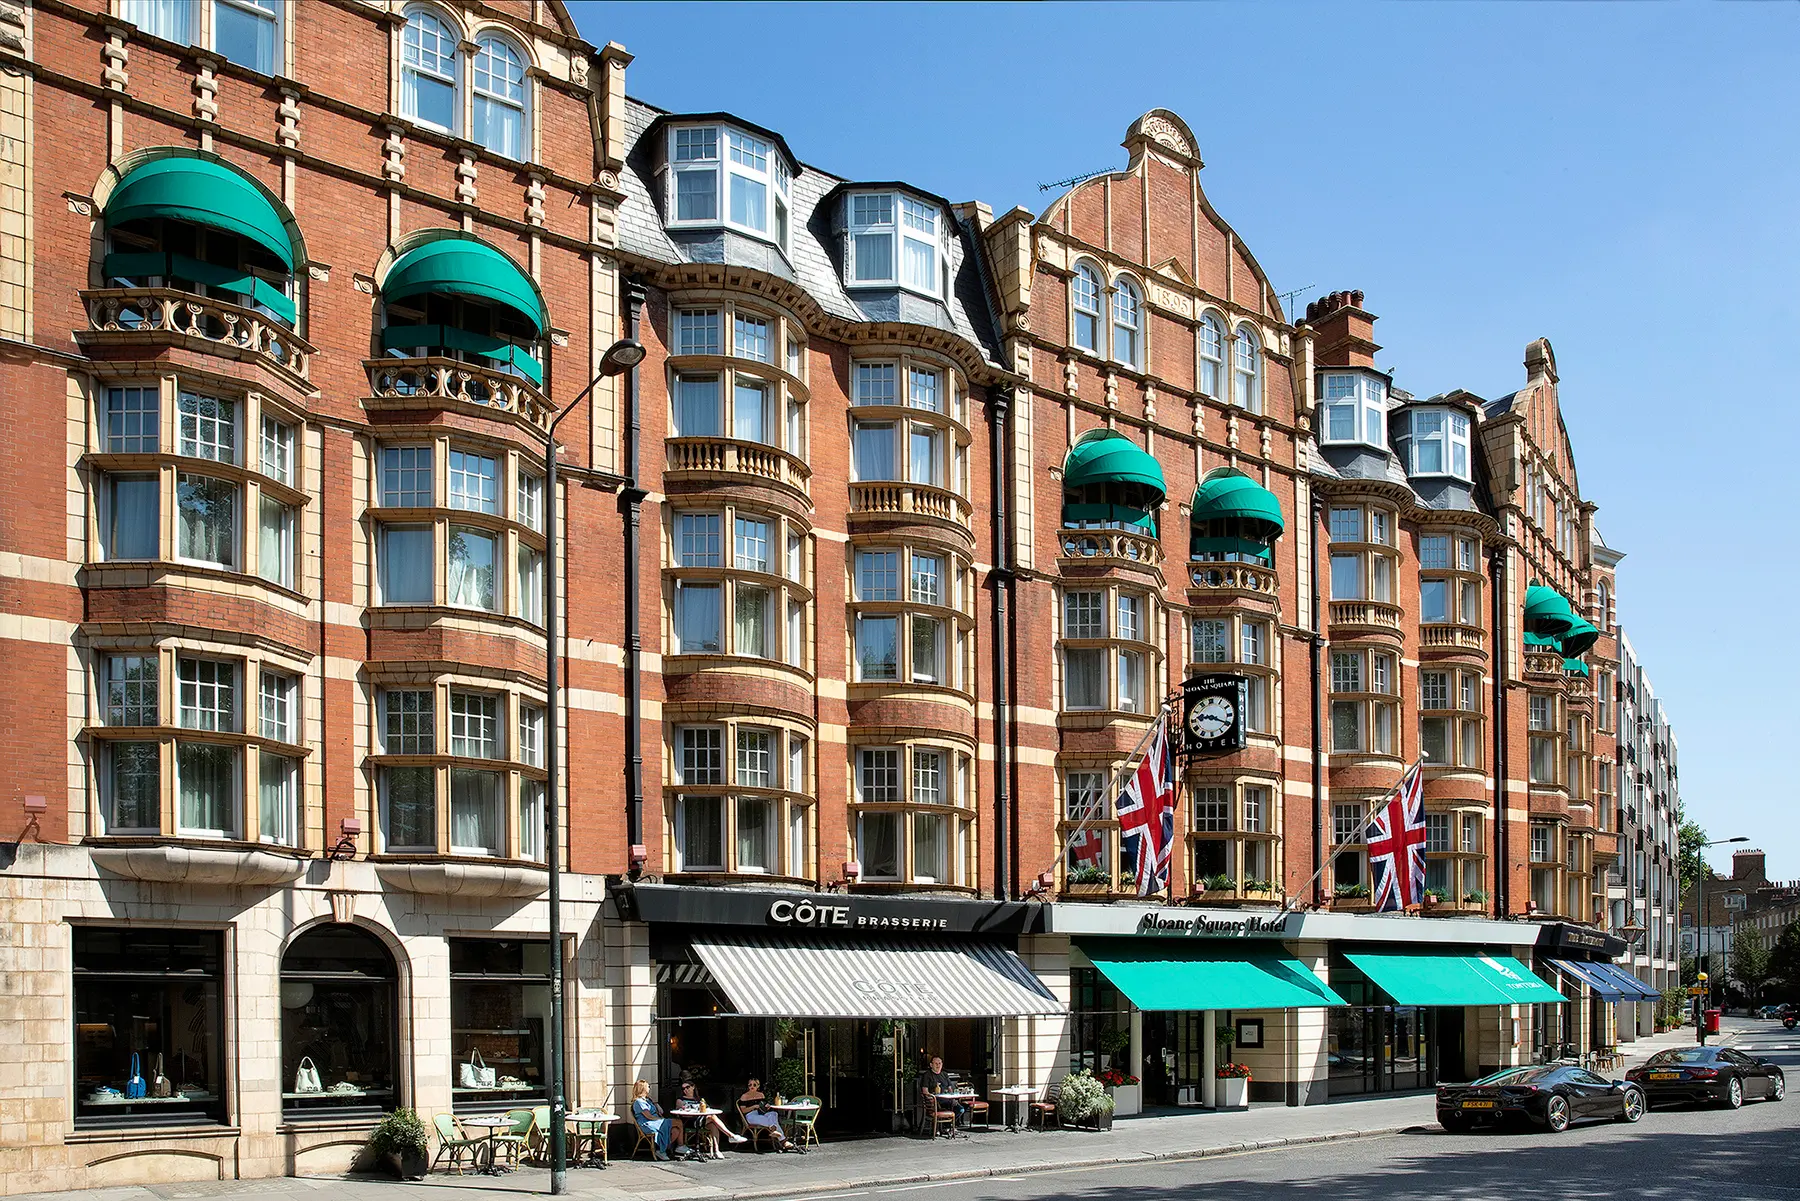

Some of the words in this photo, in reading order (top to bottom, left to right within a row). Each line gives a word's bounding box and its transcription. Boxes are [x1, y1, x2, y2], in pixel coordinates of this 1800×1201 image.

[1156, 288, 1189, 313] 1895
[1185, 738, 1237, 750] HOTEL
[770, 898, 851, 925] CÔTE
[857, 916, 948, 928] BRASSERIE
[1142, 912, 1194, 930] Sloane
[1197, 914, 1245, 933] Square
[1249, 916, 1288, 932] Hotel
